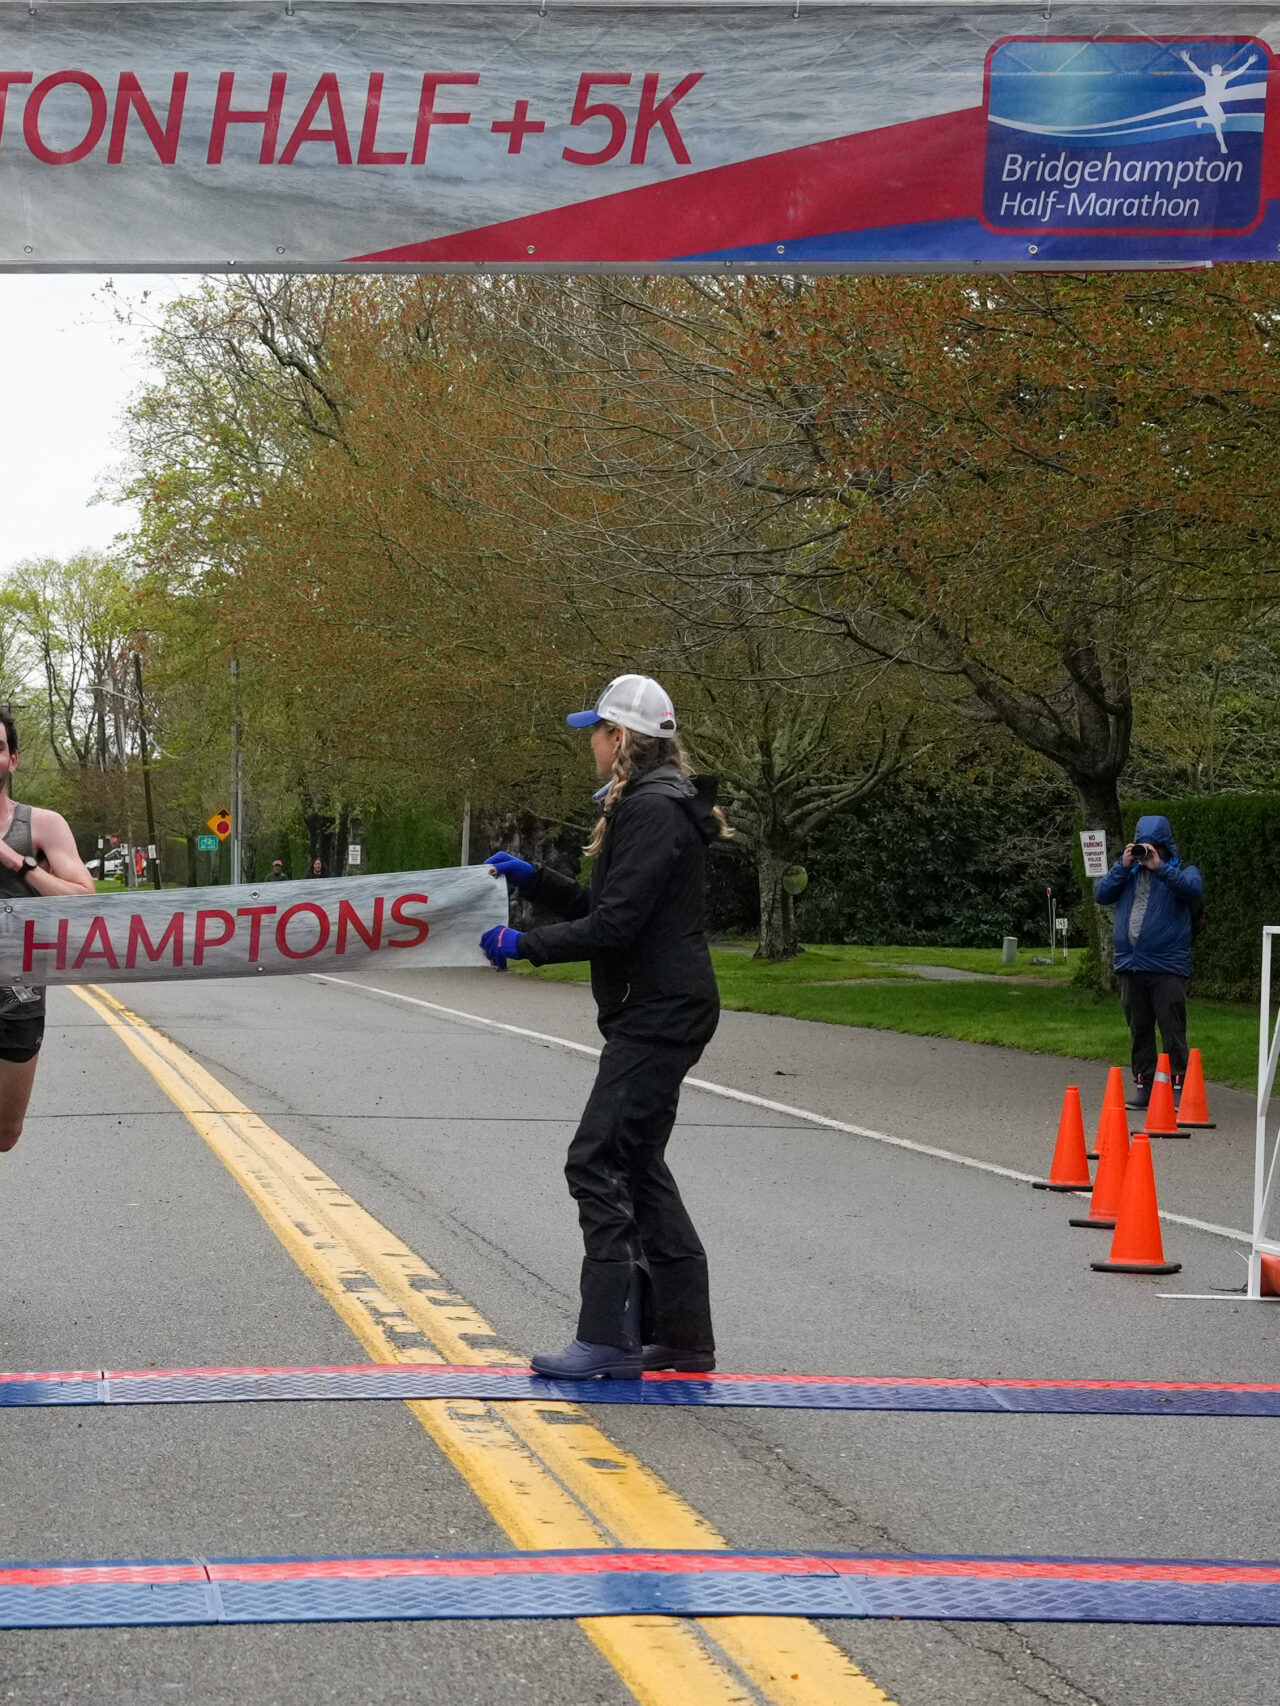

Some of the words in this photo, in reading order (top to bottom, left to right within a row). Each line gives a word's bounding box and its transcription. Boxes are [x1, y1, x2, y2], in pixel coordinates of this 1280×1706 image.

[207, 71, 480, 165] HALF
[490, 99, 546, 155] +
[562, 72, 705, 166] 5K
[1001, 152, 1243, 189] Bridgehampton
[1000, 191, 1200, 222] Half-Marathon
[22, 893, 429, 972] HAMPTONS
